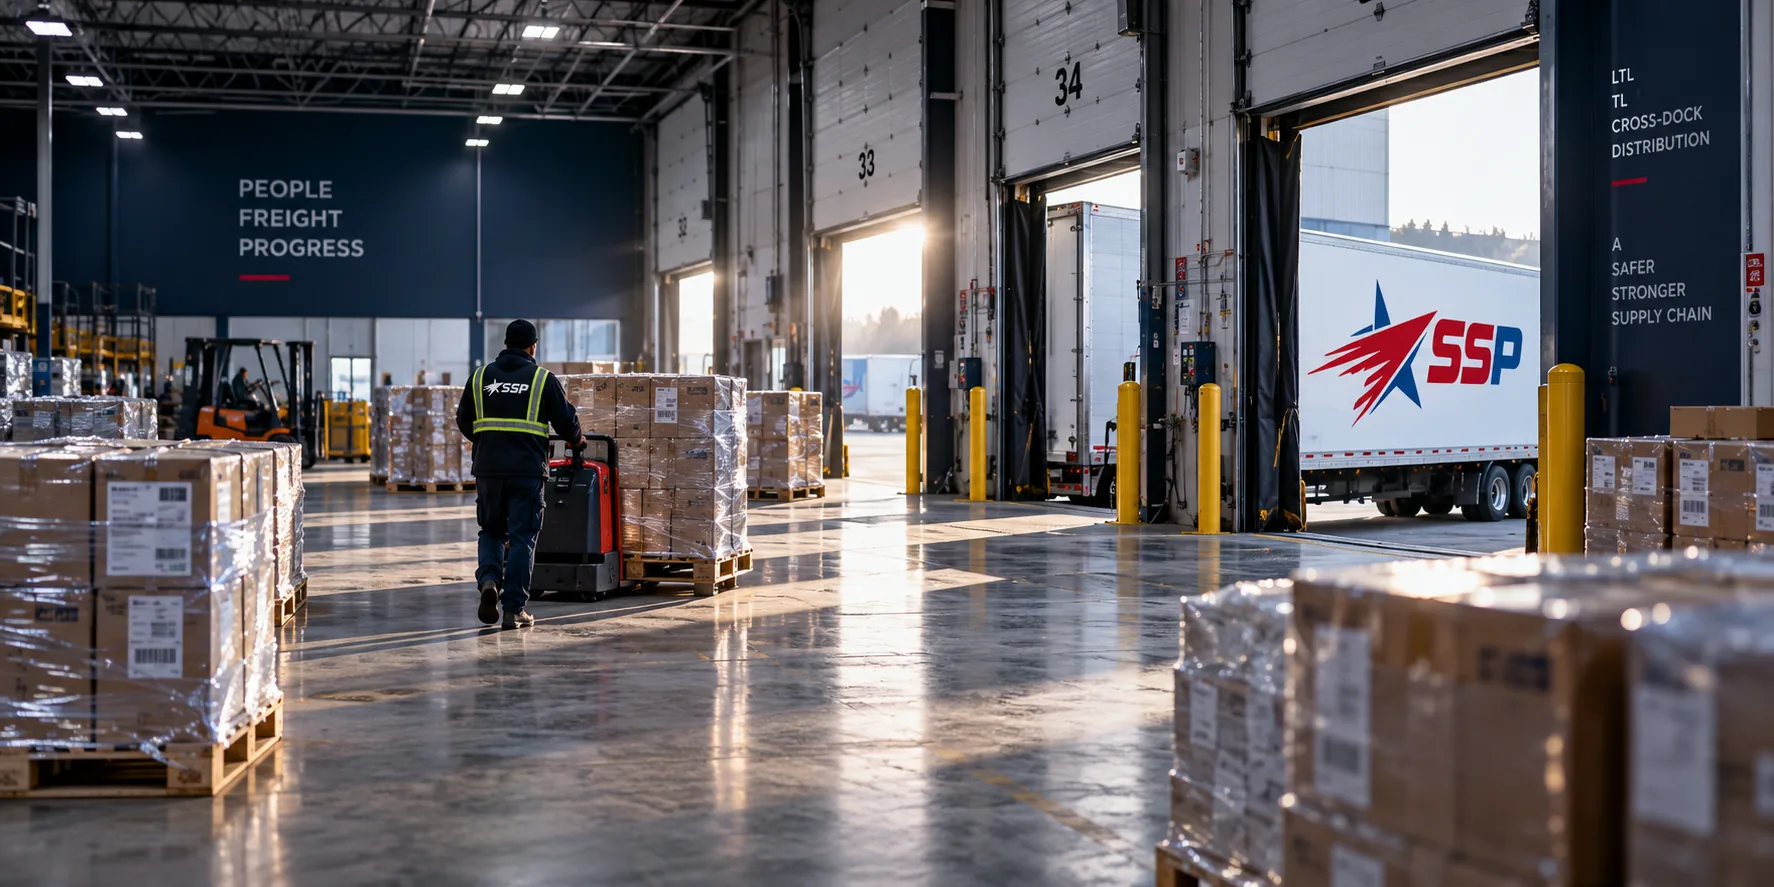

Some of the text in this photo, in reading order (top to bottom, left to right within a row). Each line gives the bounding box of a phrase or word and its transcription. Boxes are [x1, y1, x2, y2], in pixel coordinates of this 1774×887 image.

[1055, 61, 1083, 106] 34
[1612, 68, 1634, 84] LTL
[1612, 93, 1628, 108] TL
[1612, 105, 1703, 133] CROSS-DOCK
[1612, 130, 1710, 158] DISTRIBUTION
[858, 149, 875, 180] 33
[239, 179, 333, 199] PEOPLE
[239, 208, 343, 228] FREIGHT
[239, 238, 364, 257] PROGRESS
[1612, 237, 1622, 251] A
[1612, 259, 1655, 276] SAFER
[1612, 282, 1686, 301] STRONGER
[1612, 306, 1712, 326] SUPPLY CHAIN
[1427, 318, 1523, 385] SSP
[501, 382, 530, 394] SSP
